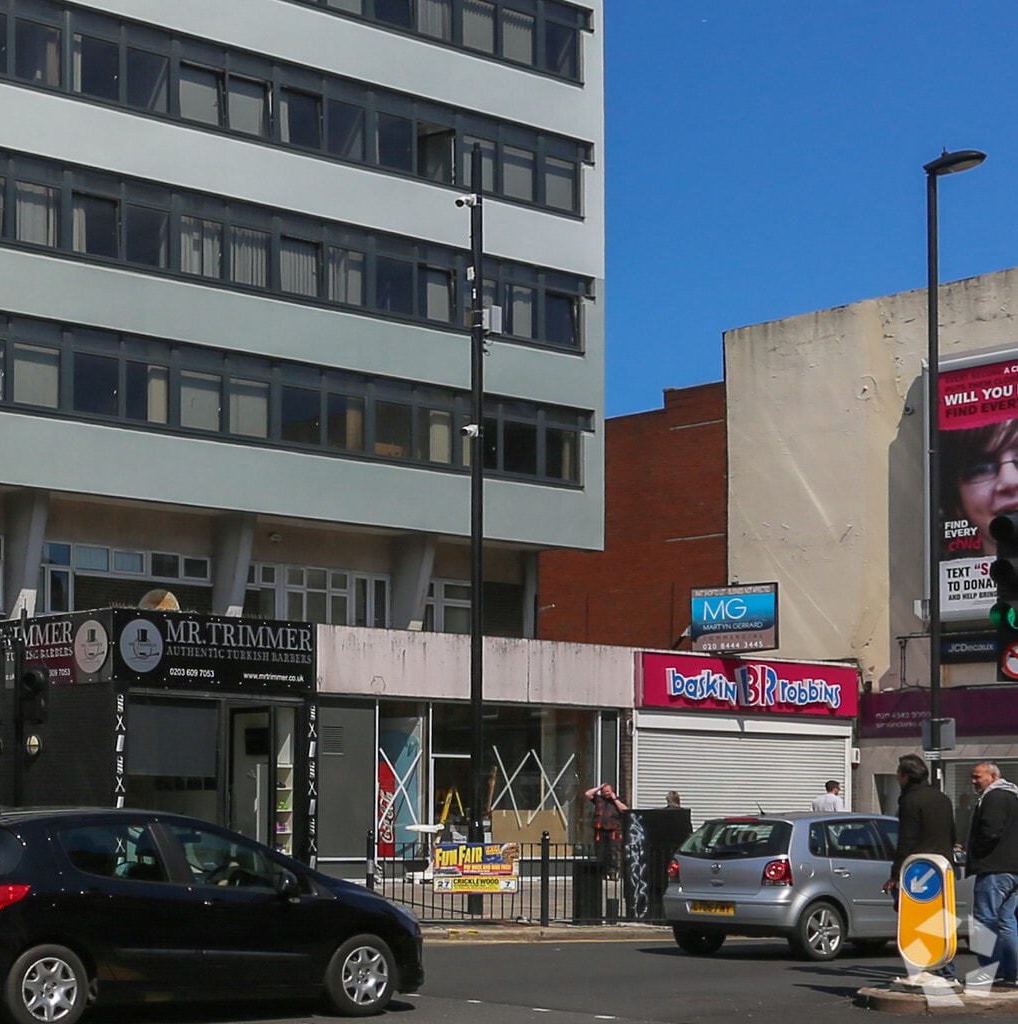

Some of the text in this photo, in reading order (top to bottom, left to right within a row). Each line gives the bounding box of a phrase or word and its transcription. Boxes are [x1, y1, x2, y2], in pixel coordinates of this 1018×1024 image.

[944, 385, 1013, 406] WILL YOU
[945, 399, 1018, 418] FIND EVER
[944, 519, 969, 530] FIND
[945, 527, 978, 538] EVERY
[948, 535, 983, 552] child
[946, 562, 991, 578] TEXT “S
[947, 578, 997, 592] TO DONA
[962, 592, 977, 600] HELP
[703, 597, 747, 621] MG
[702, 621, 763, 631] MARTYN GERRARD
[720, 642, 740, 650] 8444
[743, 641, 763, 649] 3445
[948, 643, 994, 653] JCDecaux
[40, 647, 73, 659] BARBERS
[166, 646, 312, 665] AUTHENTIC TURKISH BARBERS
[169, 667, 214, 678] 0203 609 7053
[243, 672, 304, 683] www.mrtrimmer.co.uk
[435, 847, 458, 869] FUN
[458, 844, 483, 866] FAIR
